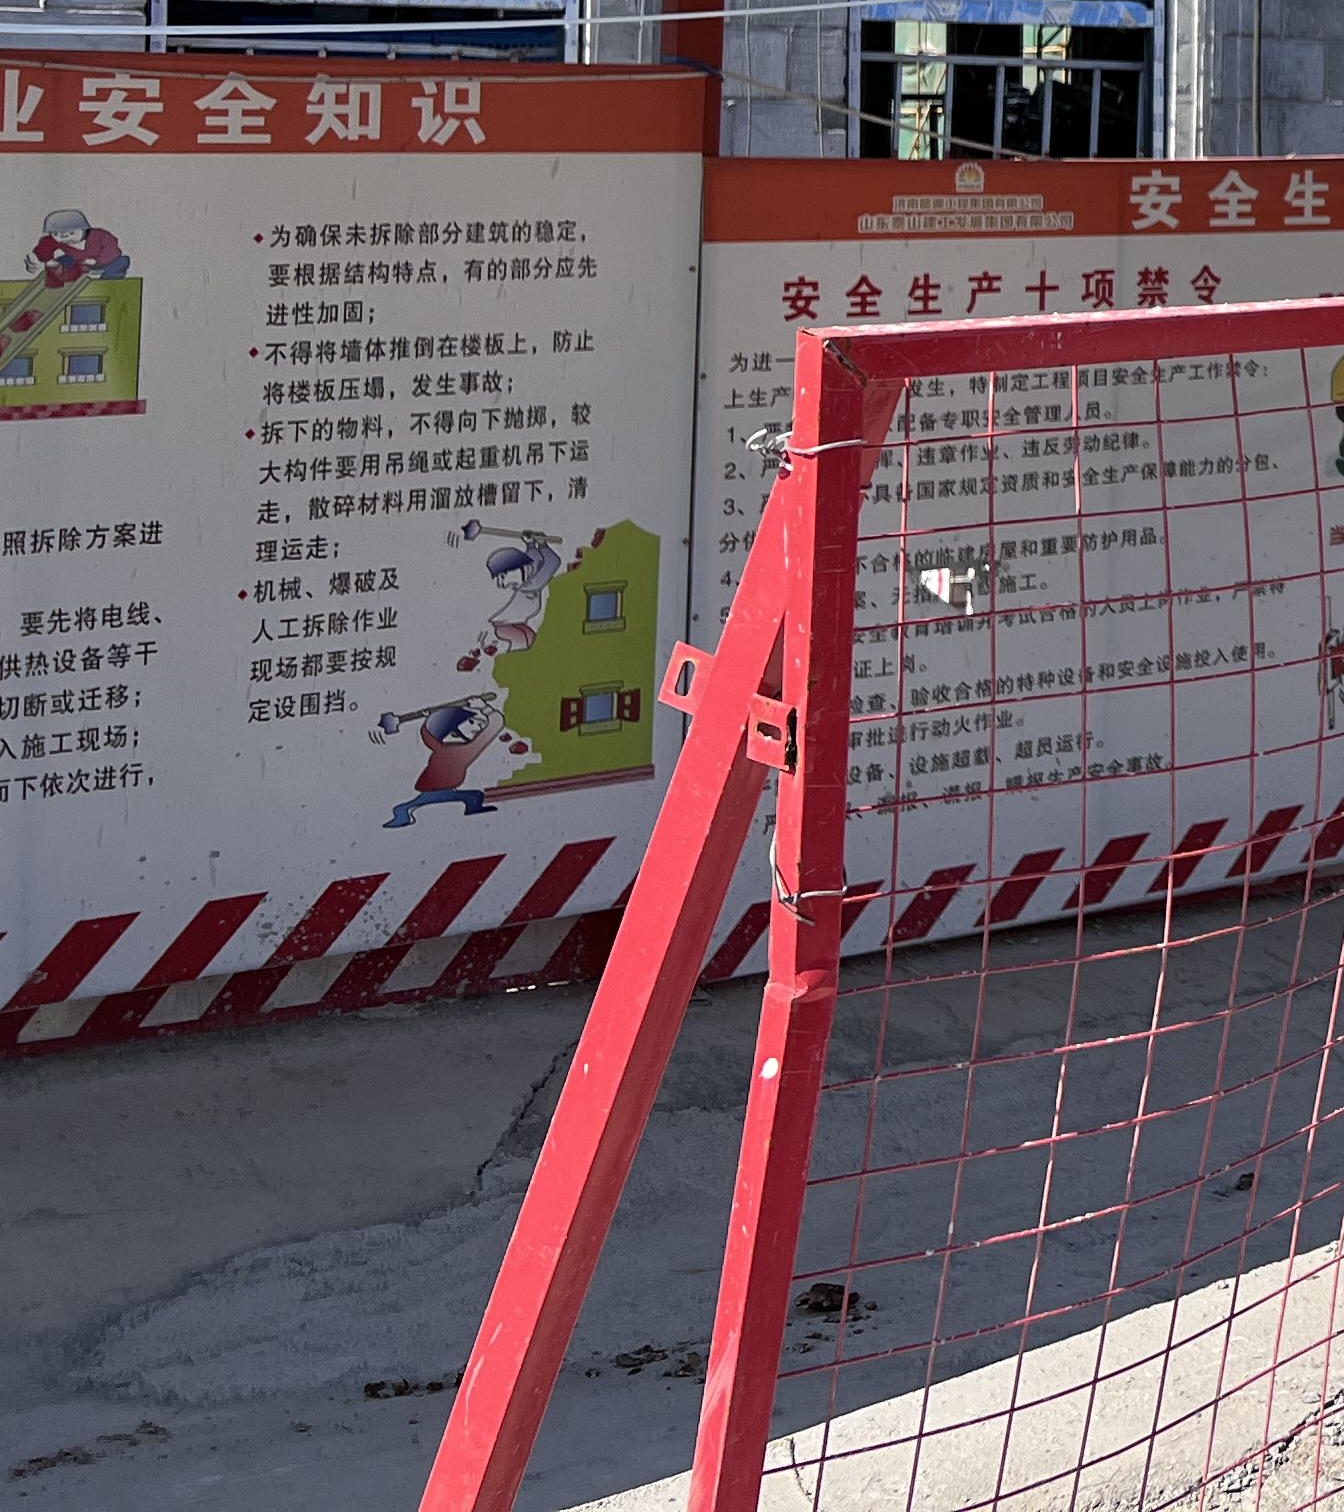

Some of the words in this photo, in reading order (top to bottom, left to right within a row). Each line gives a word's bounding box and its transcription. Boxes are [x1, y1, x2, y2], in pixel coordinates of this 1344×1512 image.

[269, 219, 587, 248] 为确保未拆除部分建筑的稳定，
[781, 264, 1222, 322] 安全生产十项禁令
[265, 299, 376, 327] 进性加固；
[258, 439, 590, 485] 大构件要用吊绳或起重机吊下运
[1, 520, 164, 557] 照拆除方案进
[254, 534, 341, 564] 理运走；
[19, 600, 163, 638] 要先将电线、
[251, 605, 399, 644] 人工拆除作业
[249, 644, 397, 683] 现场都要按规
[247, 688, 359, 724] 定设围挡。
